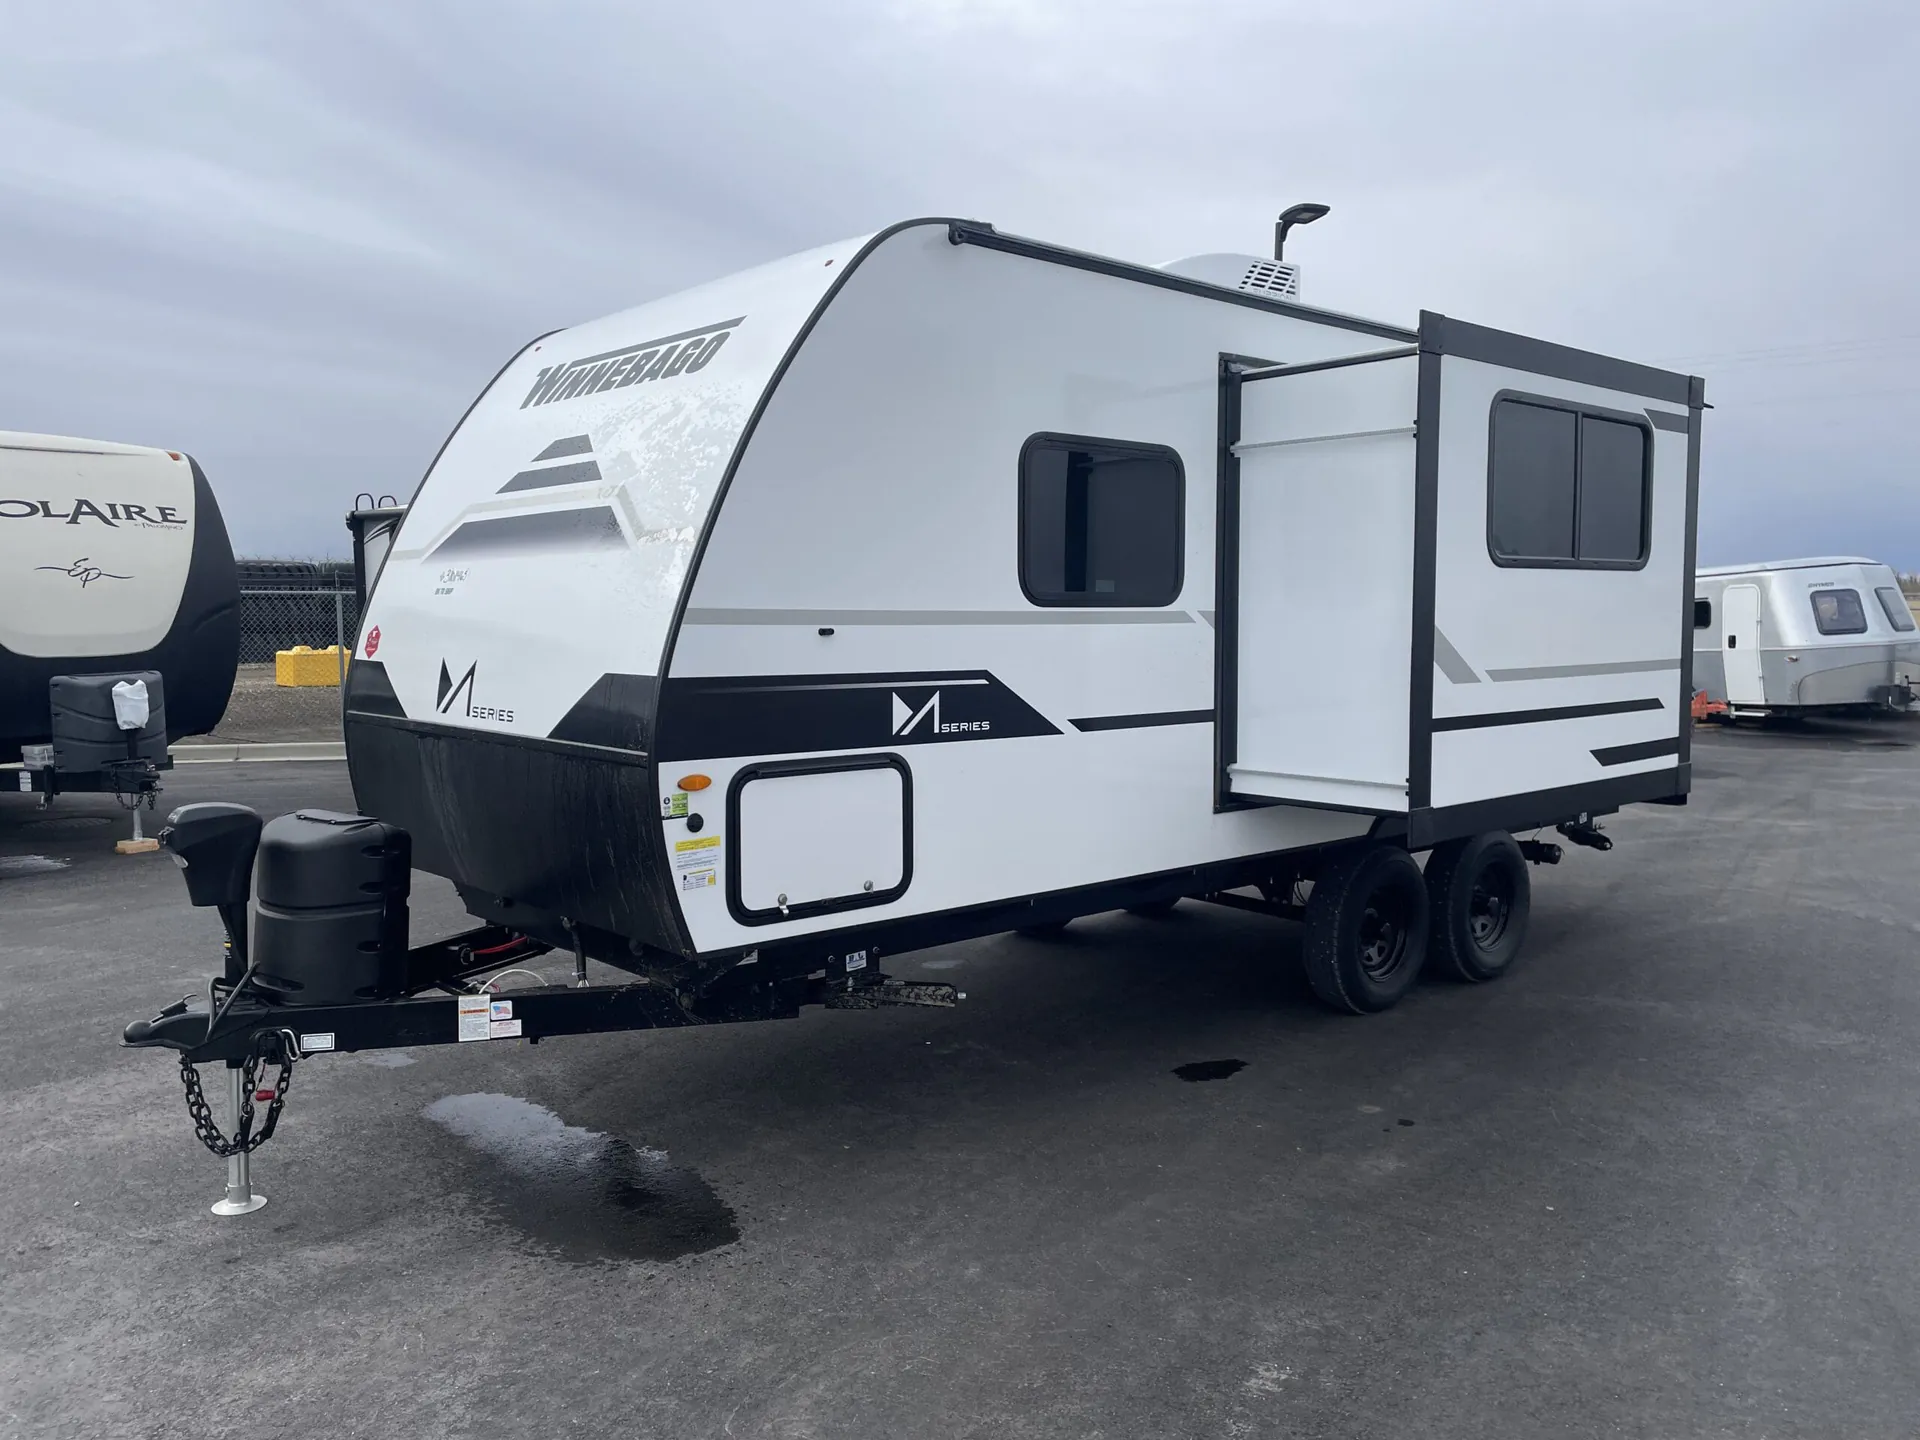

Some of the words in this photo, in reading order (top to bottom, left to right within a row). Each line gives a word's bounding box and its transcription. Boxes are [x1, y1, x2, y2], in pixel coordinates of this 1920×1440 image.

[519, 331, 731, 410] WINNEBAGO
[471, 706, 515, 723] SERIES
[941, 721, 991, 733] SERIES
